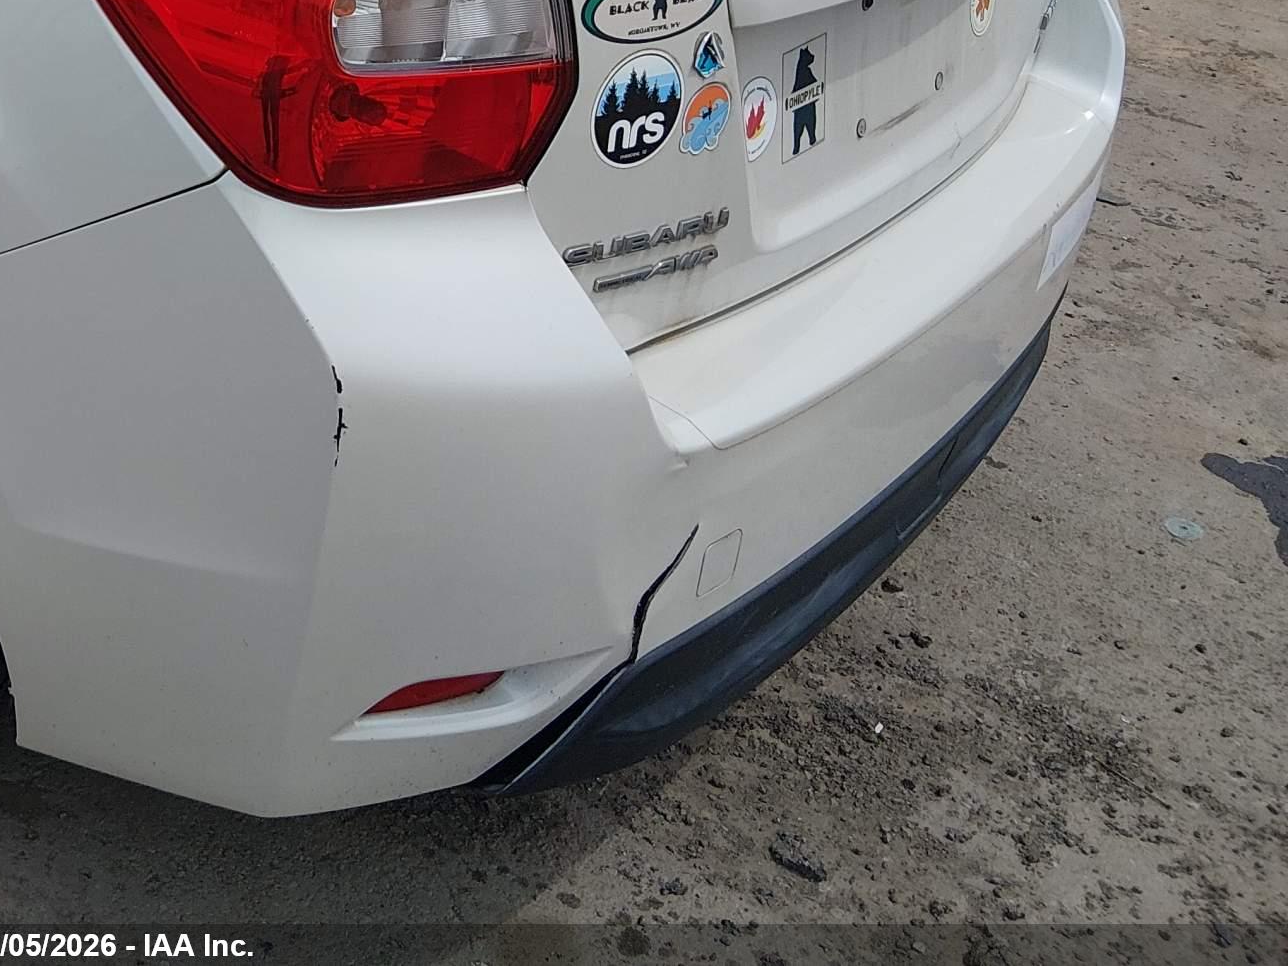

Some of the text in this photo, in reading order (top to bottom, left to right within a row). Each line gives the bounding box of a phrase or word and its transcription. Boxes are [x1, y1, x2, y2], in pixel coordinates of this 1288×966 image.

[609, 0, 650, 16] BLACK
[607, 111, 665, 153] nrs
[562, 206, 730, 267] SUBARU
